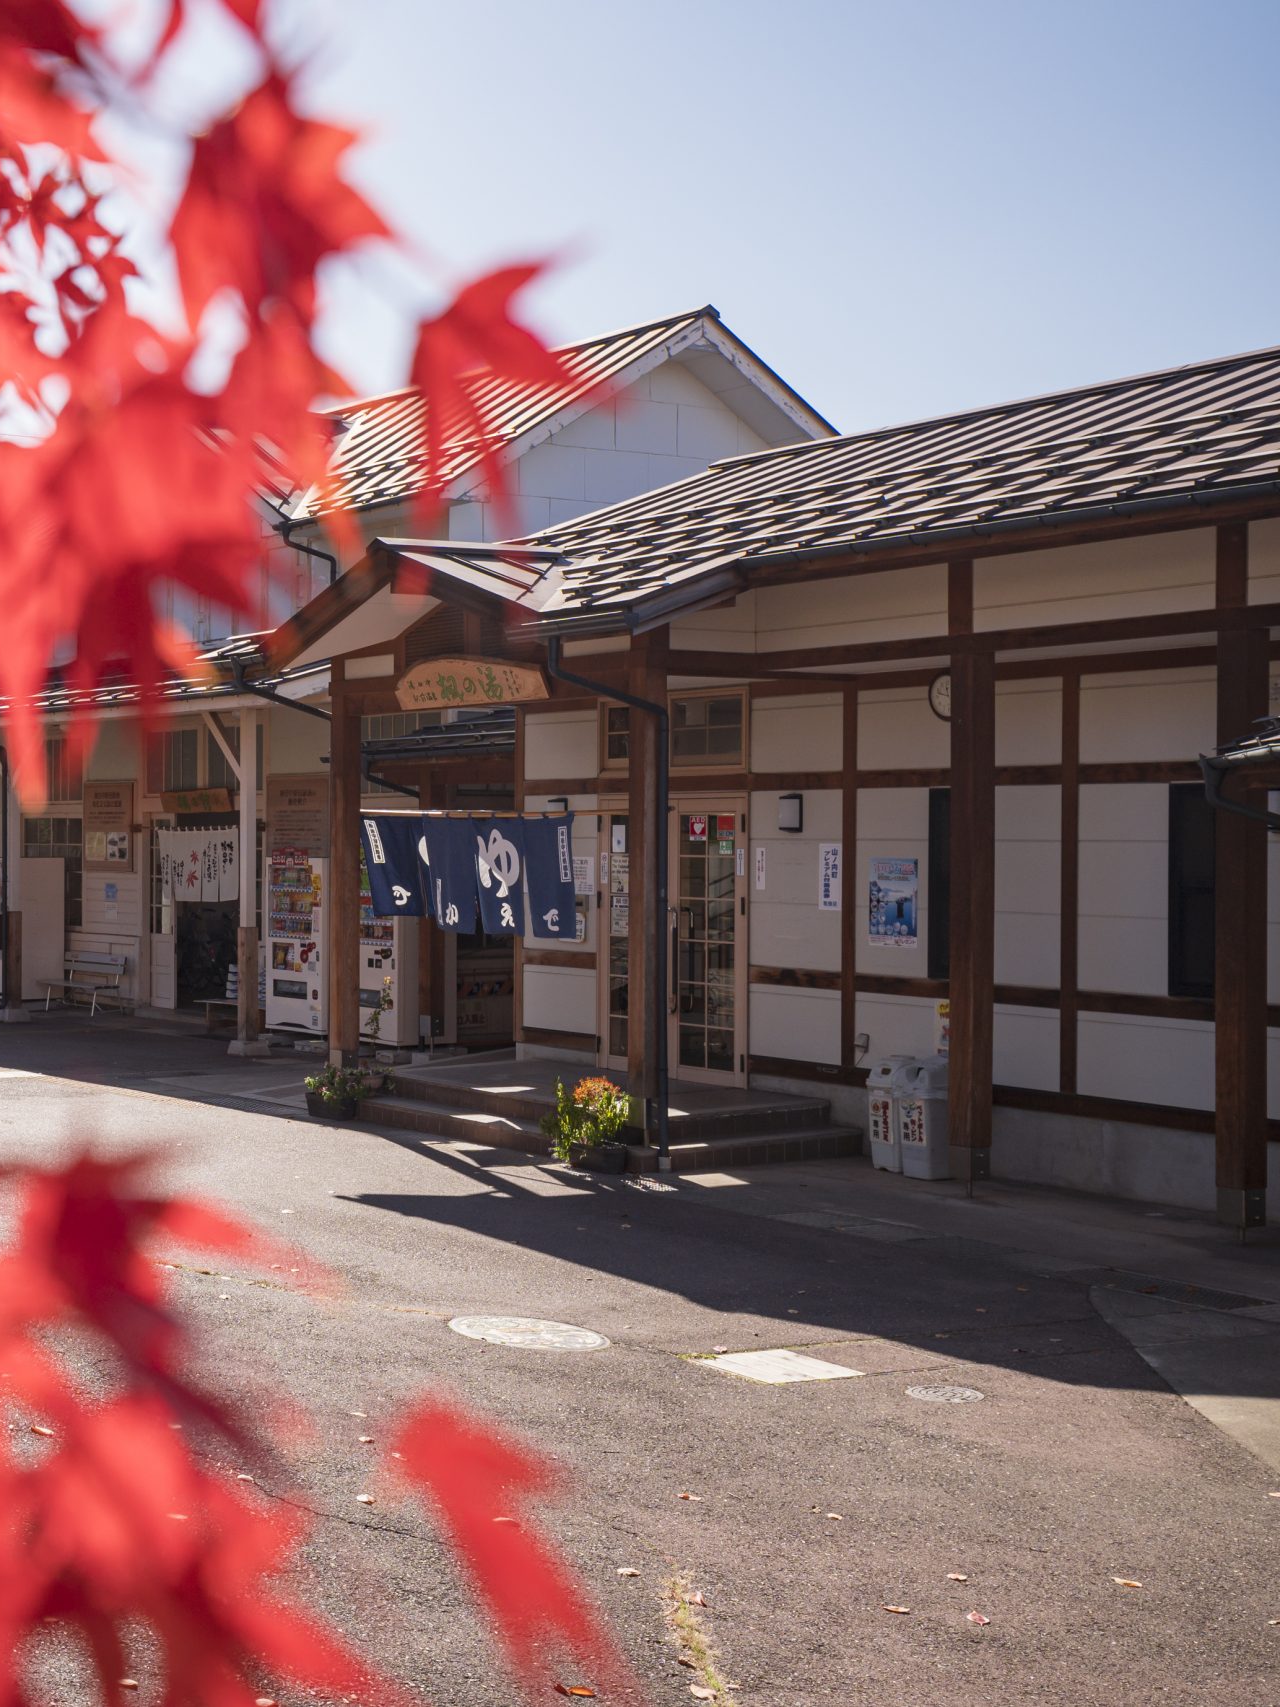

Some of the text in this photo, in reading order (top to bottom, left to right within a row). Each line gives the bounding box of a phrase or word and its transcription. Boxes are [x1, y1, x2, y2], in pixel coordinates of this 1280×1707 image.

[437, 666, 504, 701] 楓の湯
[477, 829, 520, 898] ゆ
[831, 848, 839, 879] 山ノ内町
